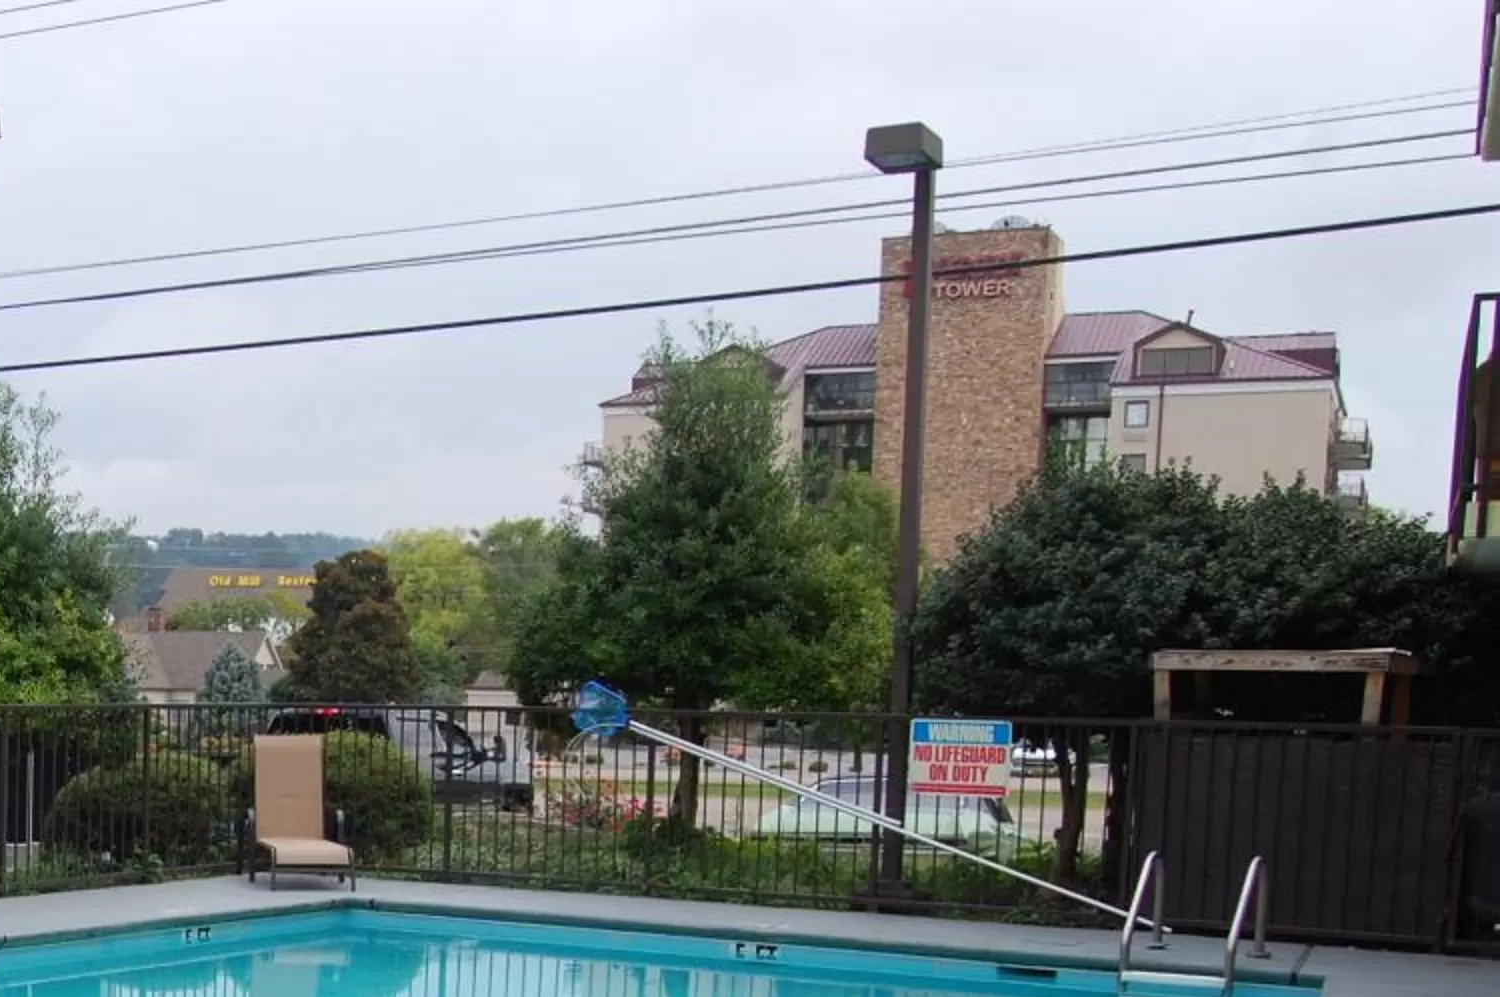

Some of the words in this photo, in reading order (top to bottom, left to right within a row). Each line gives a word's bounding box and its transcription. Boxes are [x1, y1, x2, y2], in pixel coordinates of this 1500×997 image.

[934, 279, 1011, 299] TOWER
[928, 723, 995, 743] WARNING
[914, 745, 932, 762] NO
[936, 746, 1005, 764] LIFEGUARD
[930, 764, 947, 781] ON
[953, 766, 988, 782] DUTY
